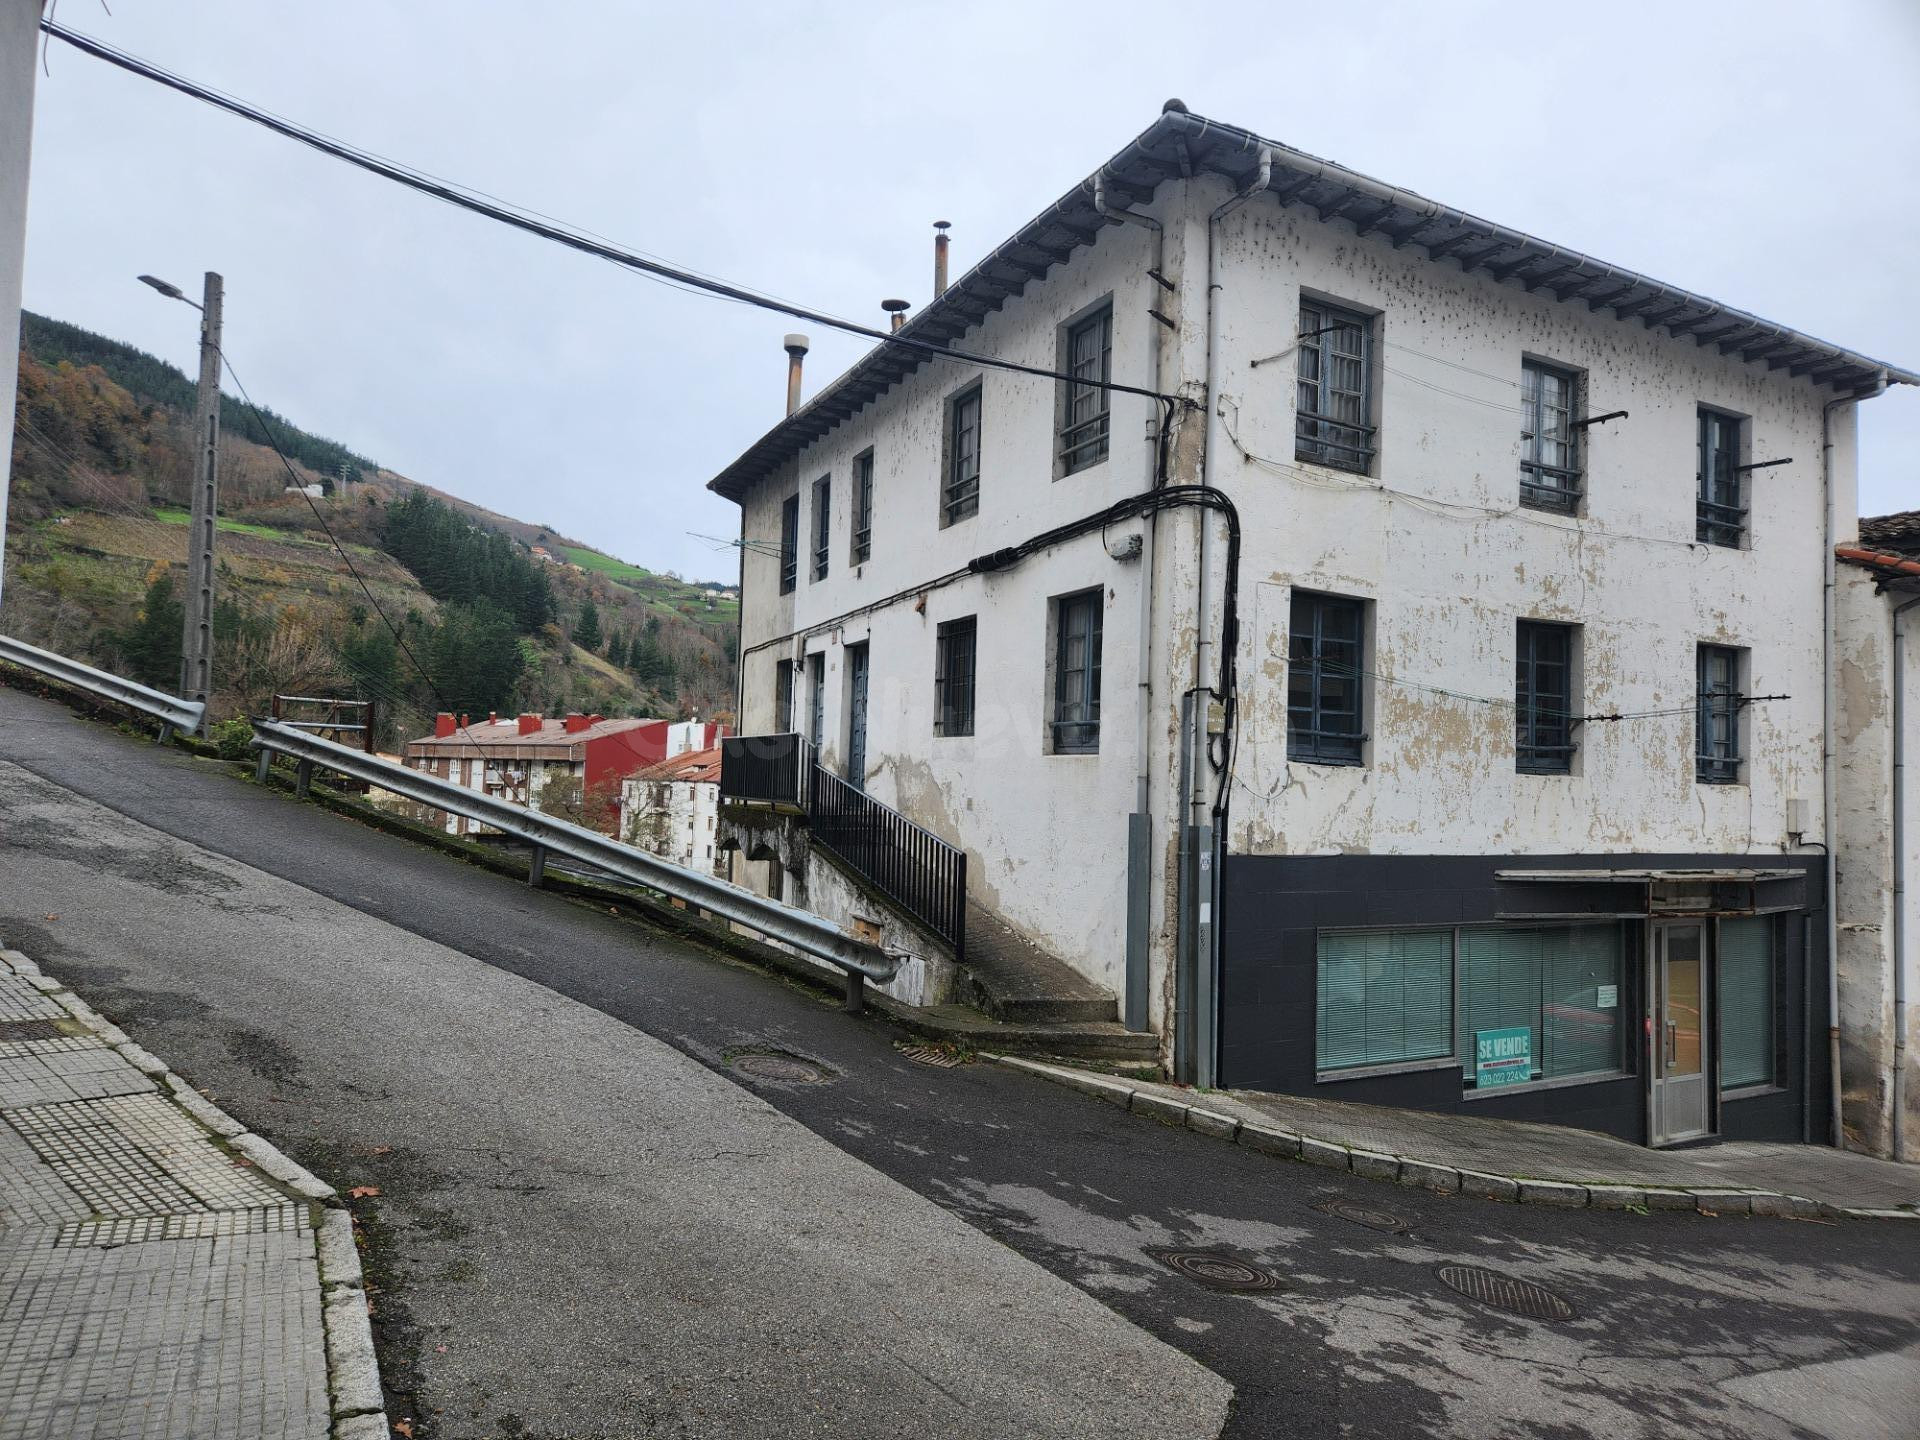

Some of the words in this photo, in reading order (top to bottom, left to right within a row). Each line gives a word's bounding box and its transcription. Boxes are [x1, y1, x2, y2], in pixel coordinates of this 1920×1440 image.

[1479, 1040, 1492, 1059] SE
[1494, 1036, 1529, 1057] VENDE
[1506, 1070, 1519, 1082] 224
